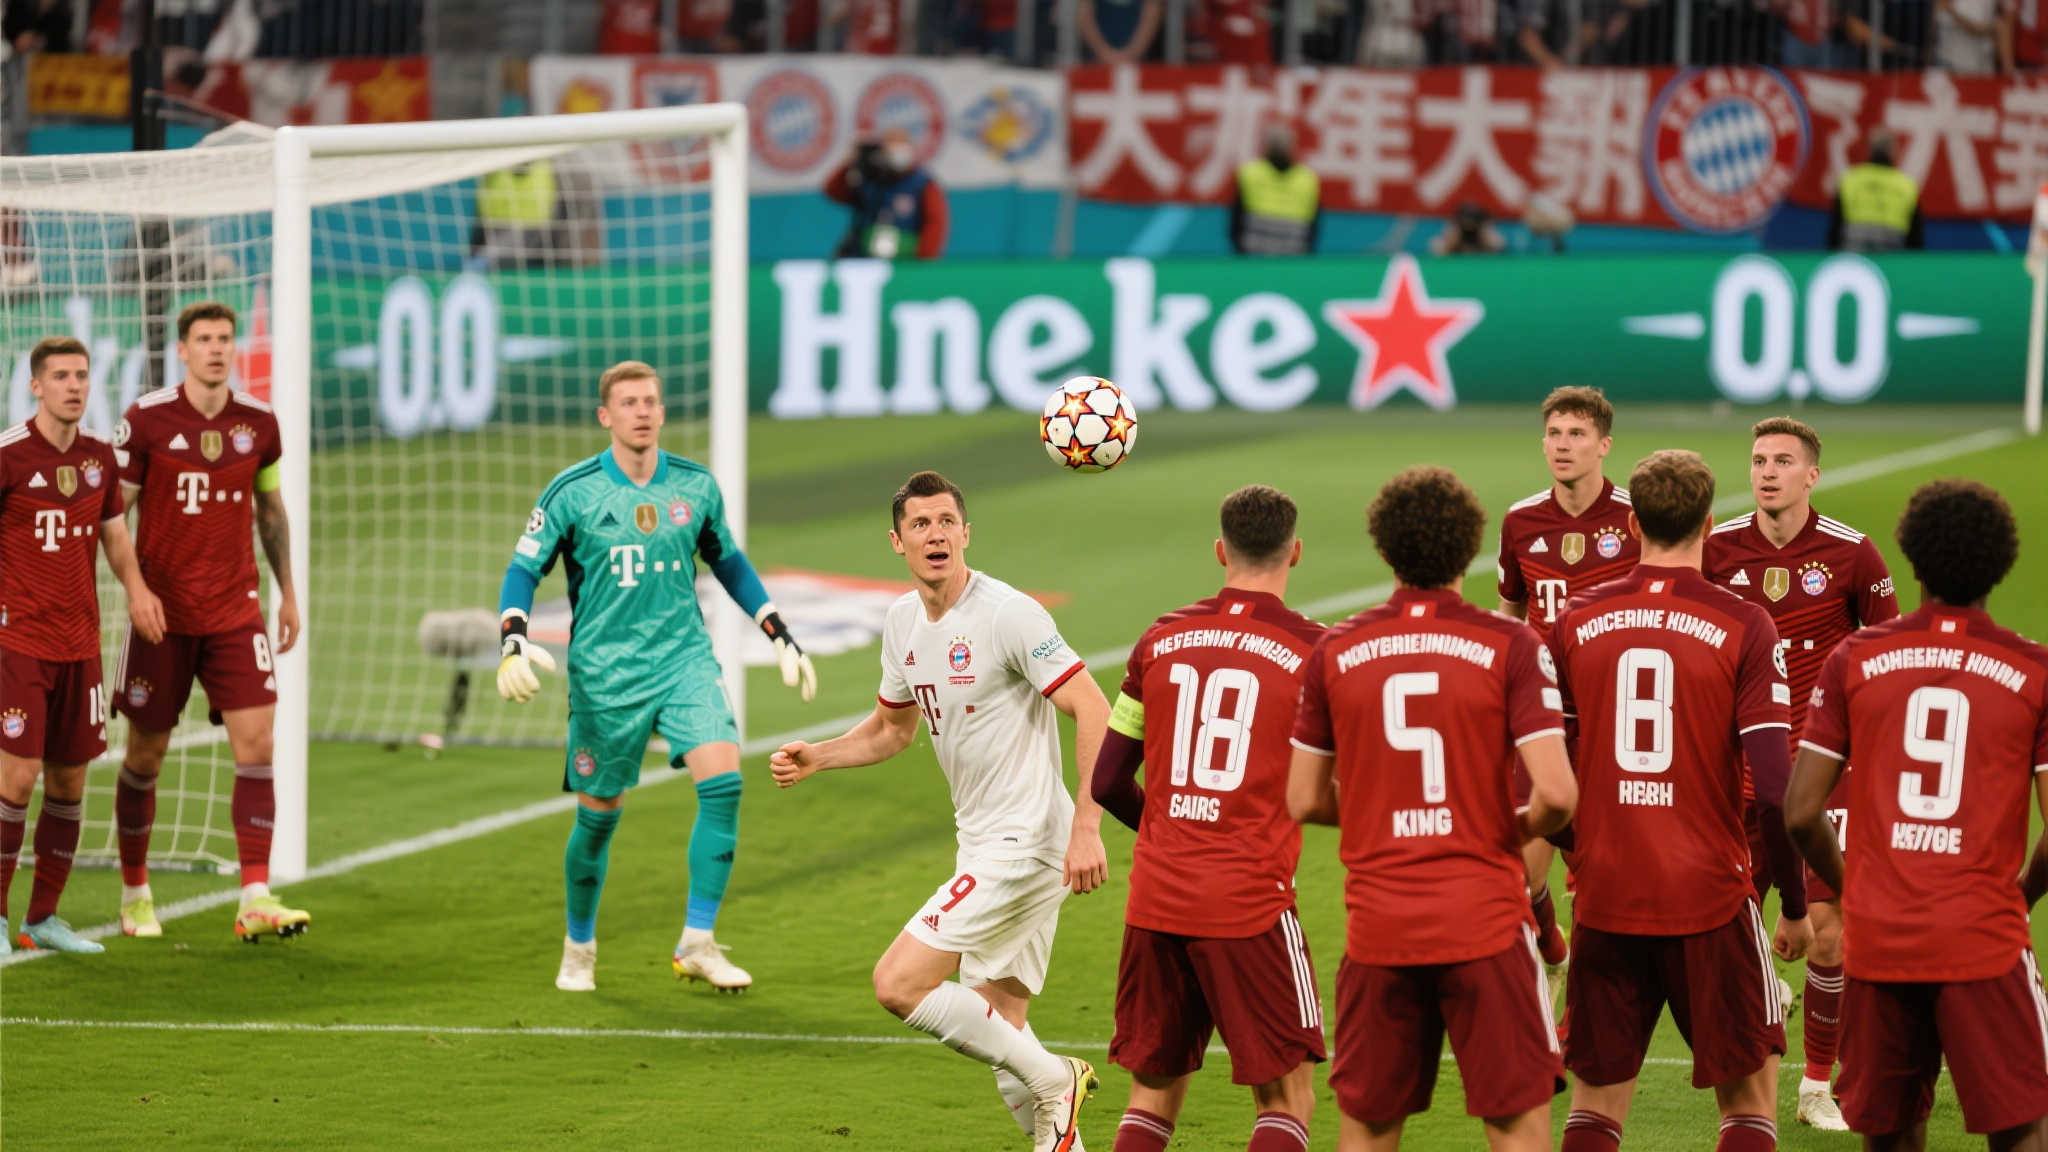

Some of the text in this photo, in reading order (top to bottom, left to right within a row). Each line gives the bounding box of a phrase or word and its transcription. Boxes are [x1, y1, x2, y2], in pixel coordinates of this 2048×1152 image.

[770, 257, 1319, 418] Hneke
[1709, 254, 1890, 402] 0.0
[253, 633, 272, 672] 8
[1615, 648, 1674, 774] 8
[1169, 663, 1260, 792] 18
[1382, 672, 1446, 803] 5
[1897, 686, 1970, 820] 9
[1393, 807, 1452, 838] KING
[940, 873, 976, 912] 9
